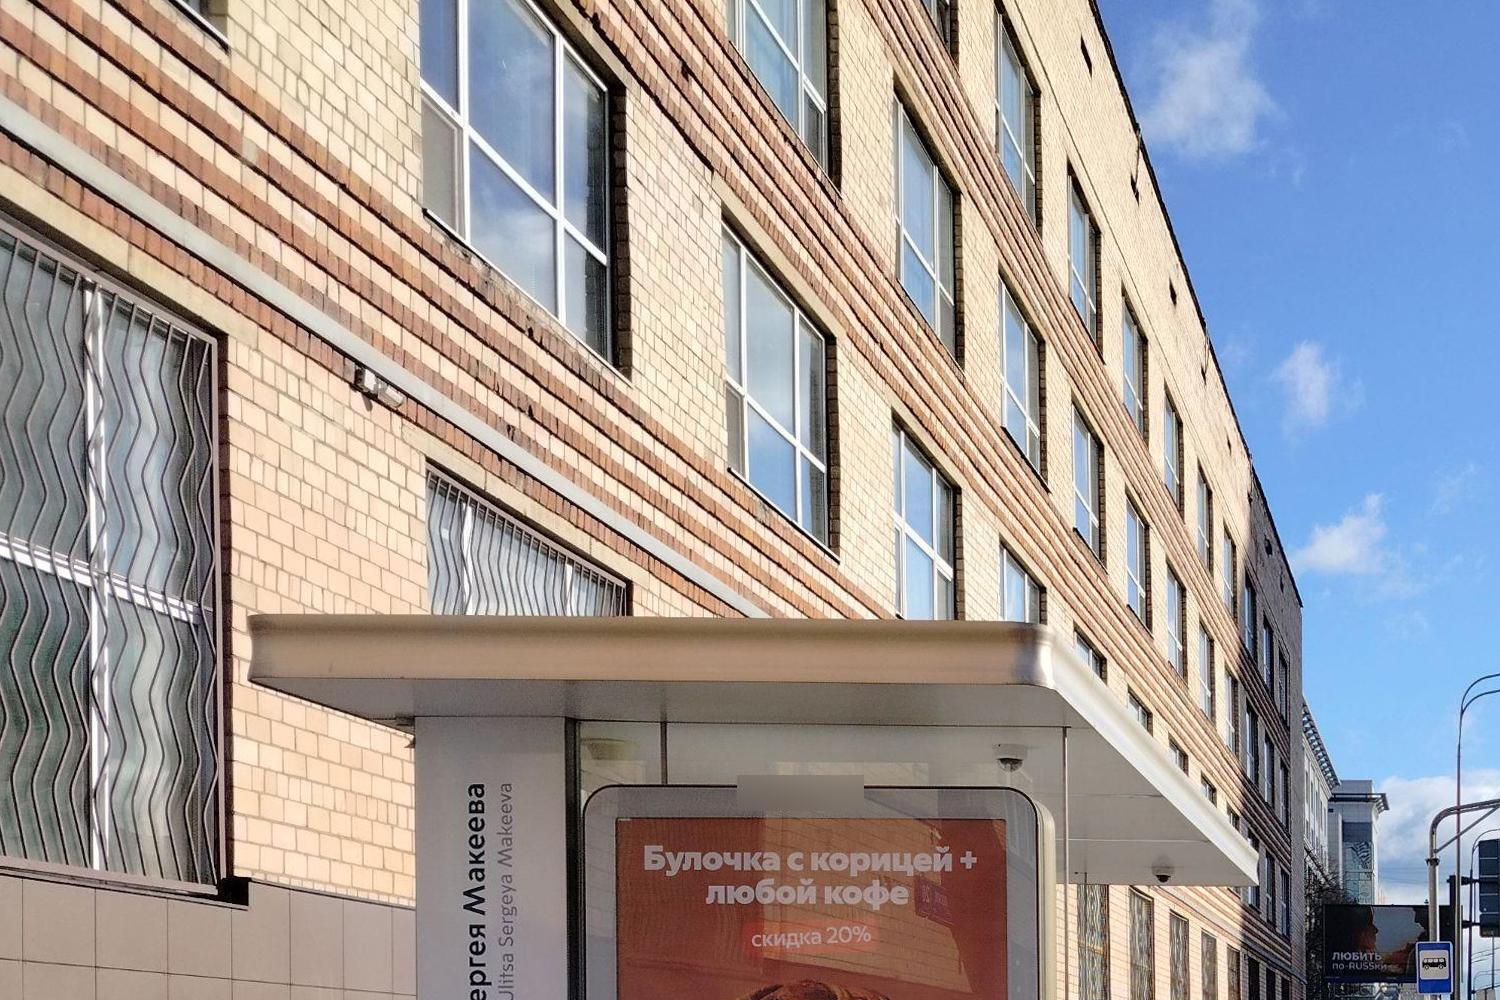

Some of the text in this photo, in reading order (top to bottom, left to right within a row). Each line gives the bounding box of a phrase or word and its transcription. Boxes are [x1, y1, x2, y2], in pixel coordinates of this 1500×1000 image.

[496, 782, 513, 867] Makeeva
[462, 783, 486, 915] Макеева
[643, 845, 977, 877] Булочка с корицей +
[498, 873, 517, 946] Sergeya
[706, 879, 909, 910] любой кофе
[751, 925, 872, 948] скидка 20%
[1332, 952, 1382, 960] ЛЮБИТЬ
